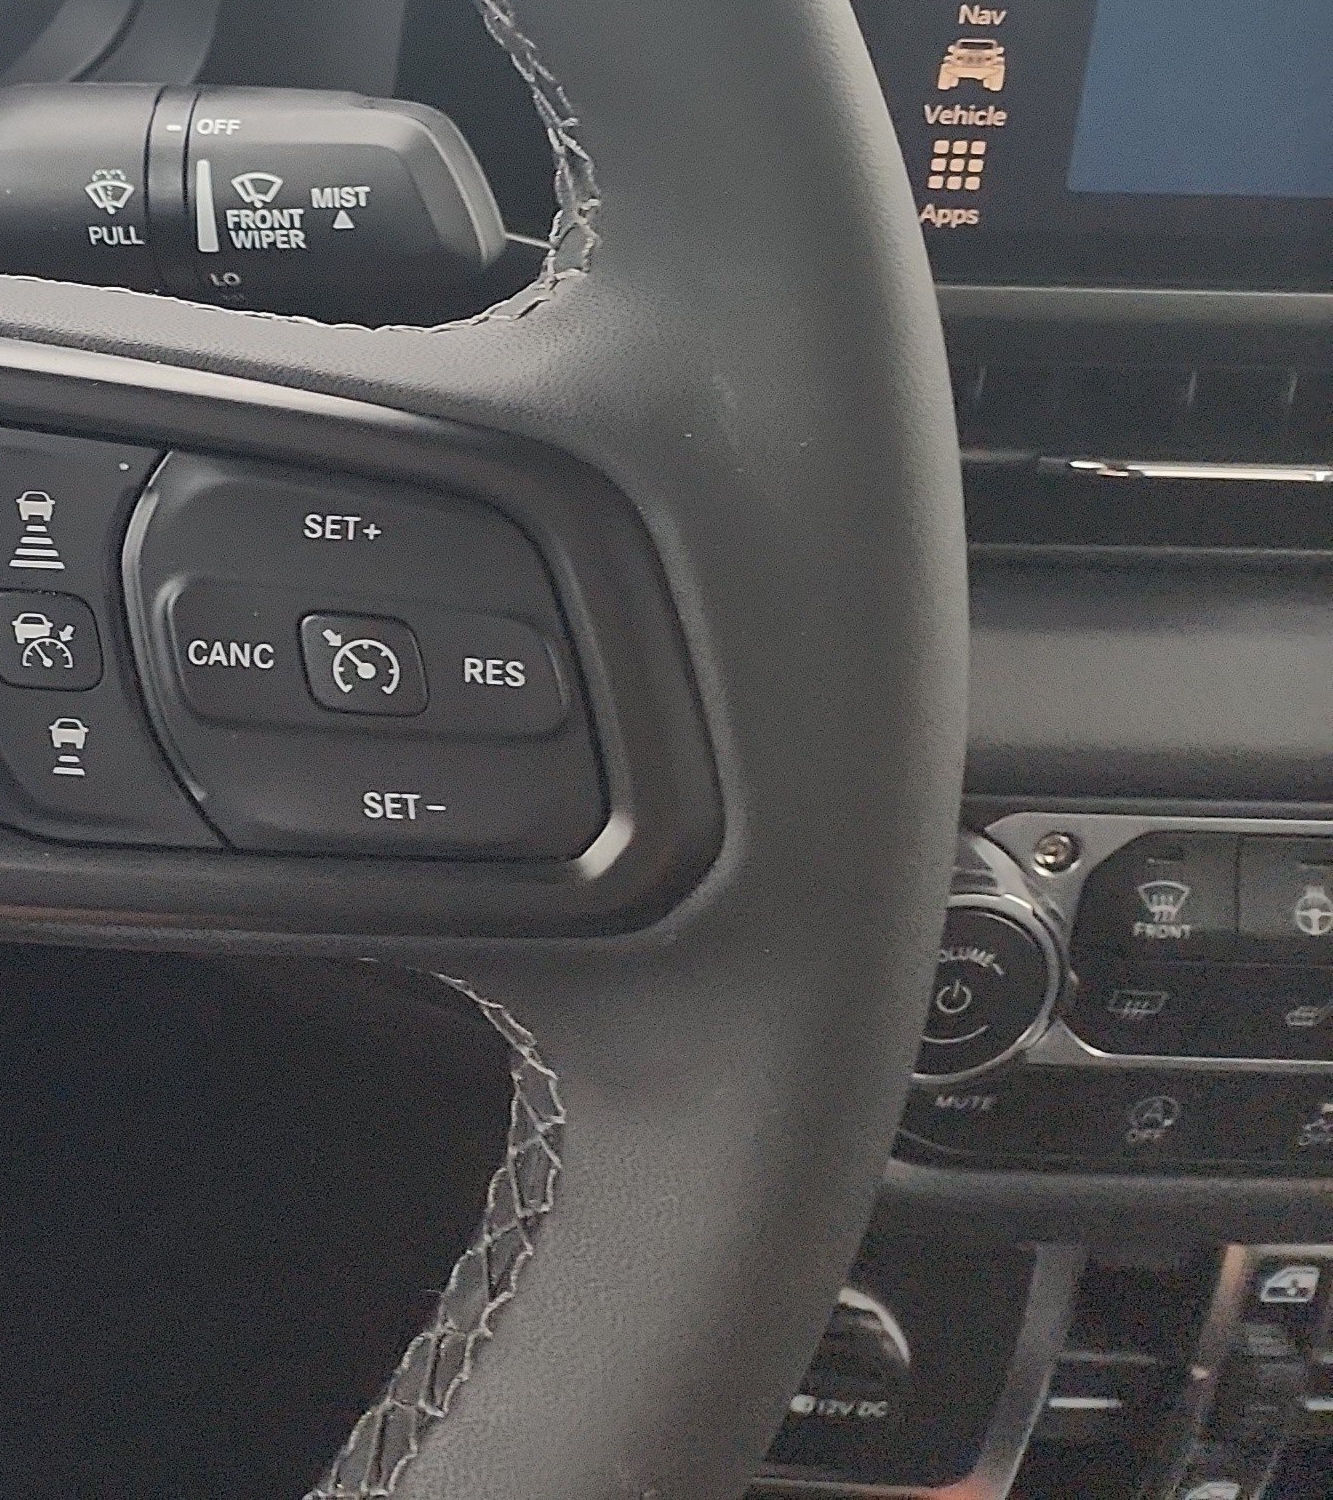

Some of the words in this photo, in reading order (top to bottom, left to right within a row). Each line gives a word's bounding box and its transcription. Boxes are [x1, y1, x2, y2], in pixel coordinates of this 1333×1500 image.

[958, 4, 1007, 27] Nav
[922, 104, 1008, 127] Vehicle
[196, 118, 241, 136] OFF
[310, 186, 372, 210] MIST
[225, 208, 305, 231] FRONT
[919, 204, 980, 229] Apps
[88, 225, 145, 247] PULL
[228, 229, 308, 250] WIPER
[210, 272, 241, 286] LO
[187, 639, 275, 670] CANC
[464, 657, 526, 688] RES
[1133, 922, 1192, 939] FRONT
[938, 946, 995, 968] OLUME
[935, 1095, 993, 1111] MUTE
